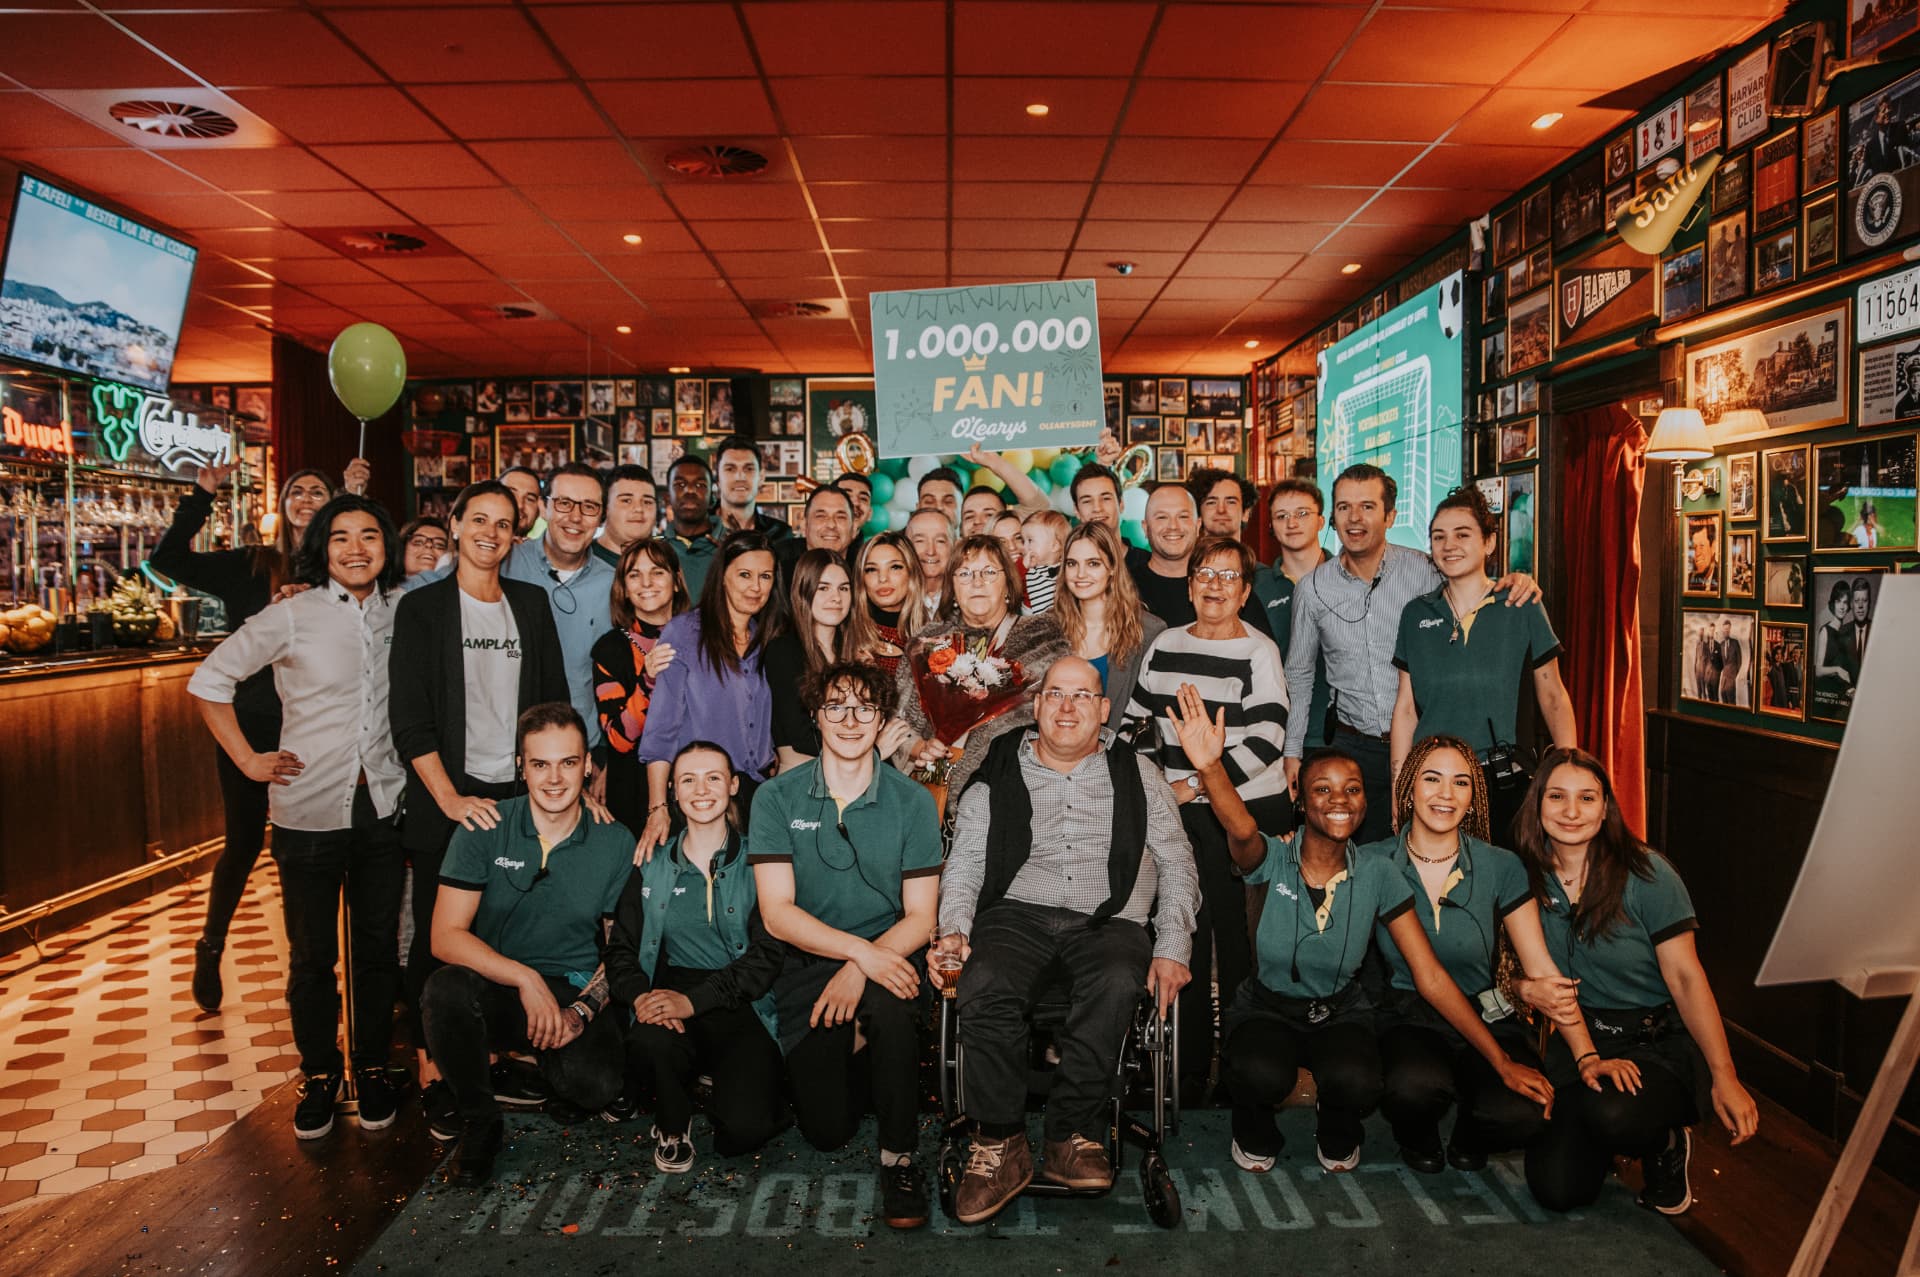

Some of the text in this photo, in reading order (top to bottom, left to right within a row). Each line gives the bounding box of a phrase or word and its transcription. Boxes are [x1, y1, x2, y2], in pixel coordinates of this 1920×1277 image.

[1731, 91, 1764, 116] PSYCHEDEL
[1737, 104, 1762, 129] CLUB
[1642, 129, 1649, 158] B
[1670, 111, 1678, 141] U
[36, 181, 72, 209] TAFEL!
[85, 204, 119, 230] BESTEL
[121, 218, 138, 238] VIA
[139, 226, 152, 242] DE
[1629, 163, 1698, 228] Sam
[1567, 269, 1632, 318] H HARVARD
[1866, 283, 1919, 326] 11564
[885, 316, 1092, 361] 1.000.000
[933, 372, 1044, 413] FAN!
[2, 406, 74, 454] Duvel
[951, 416, 1028, 442] O'Learys
[463, 637, 517, 650] AMPLAY
[1766, 628, 1783, 642] LIFE
[460, 1172, 877, 1238] BOSTON
